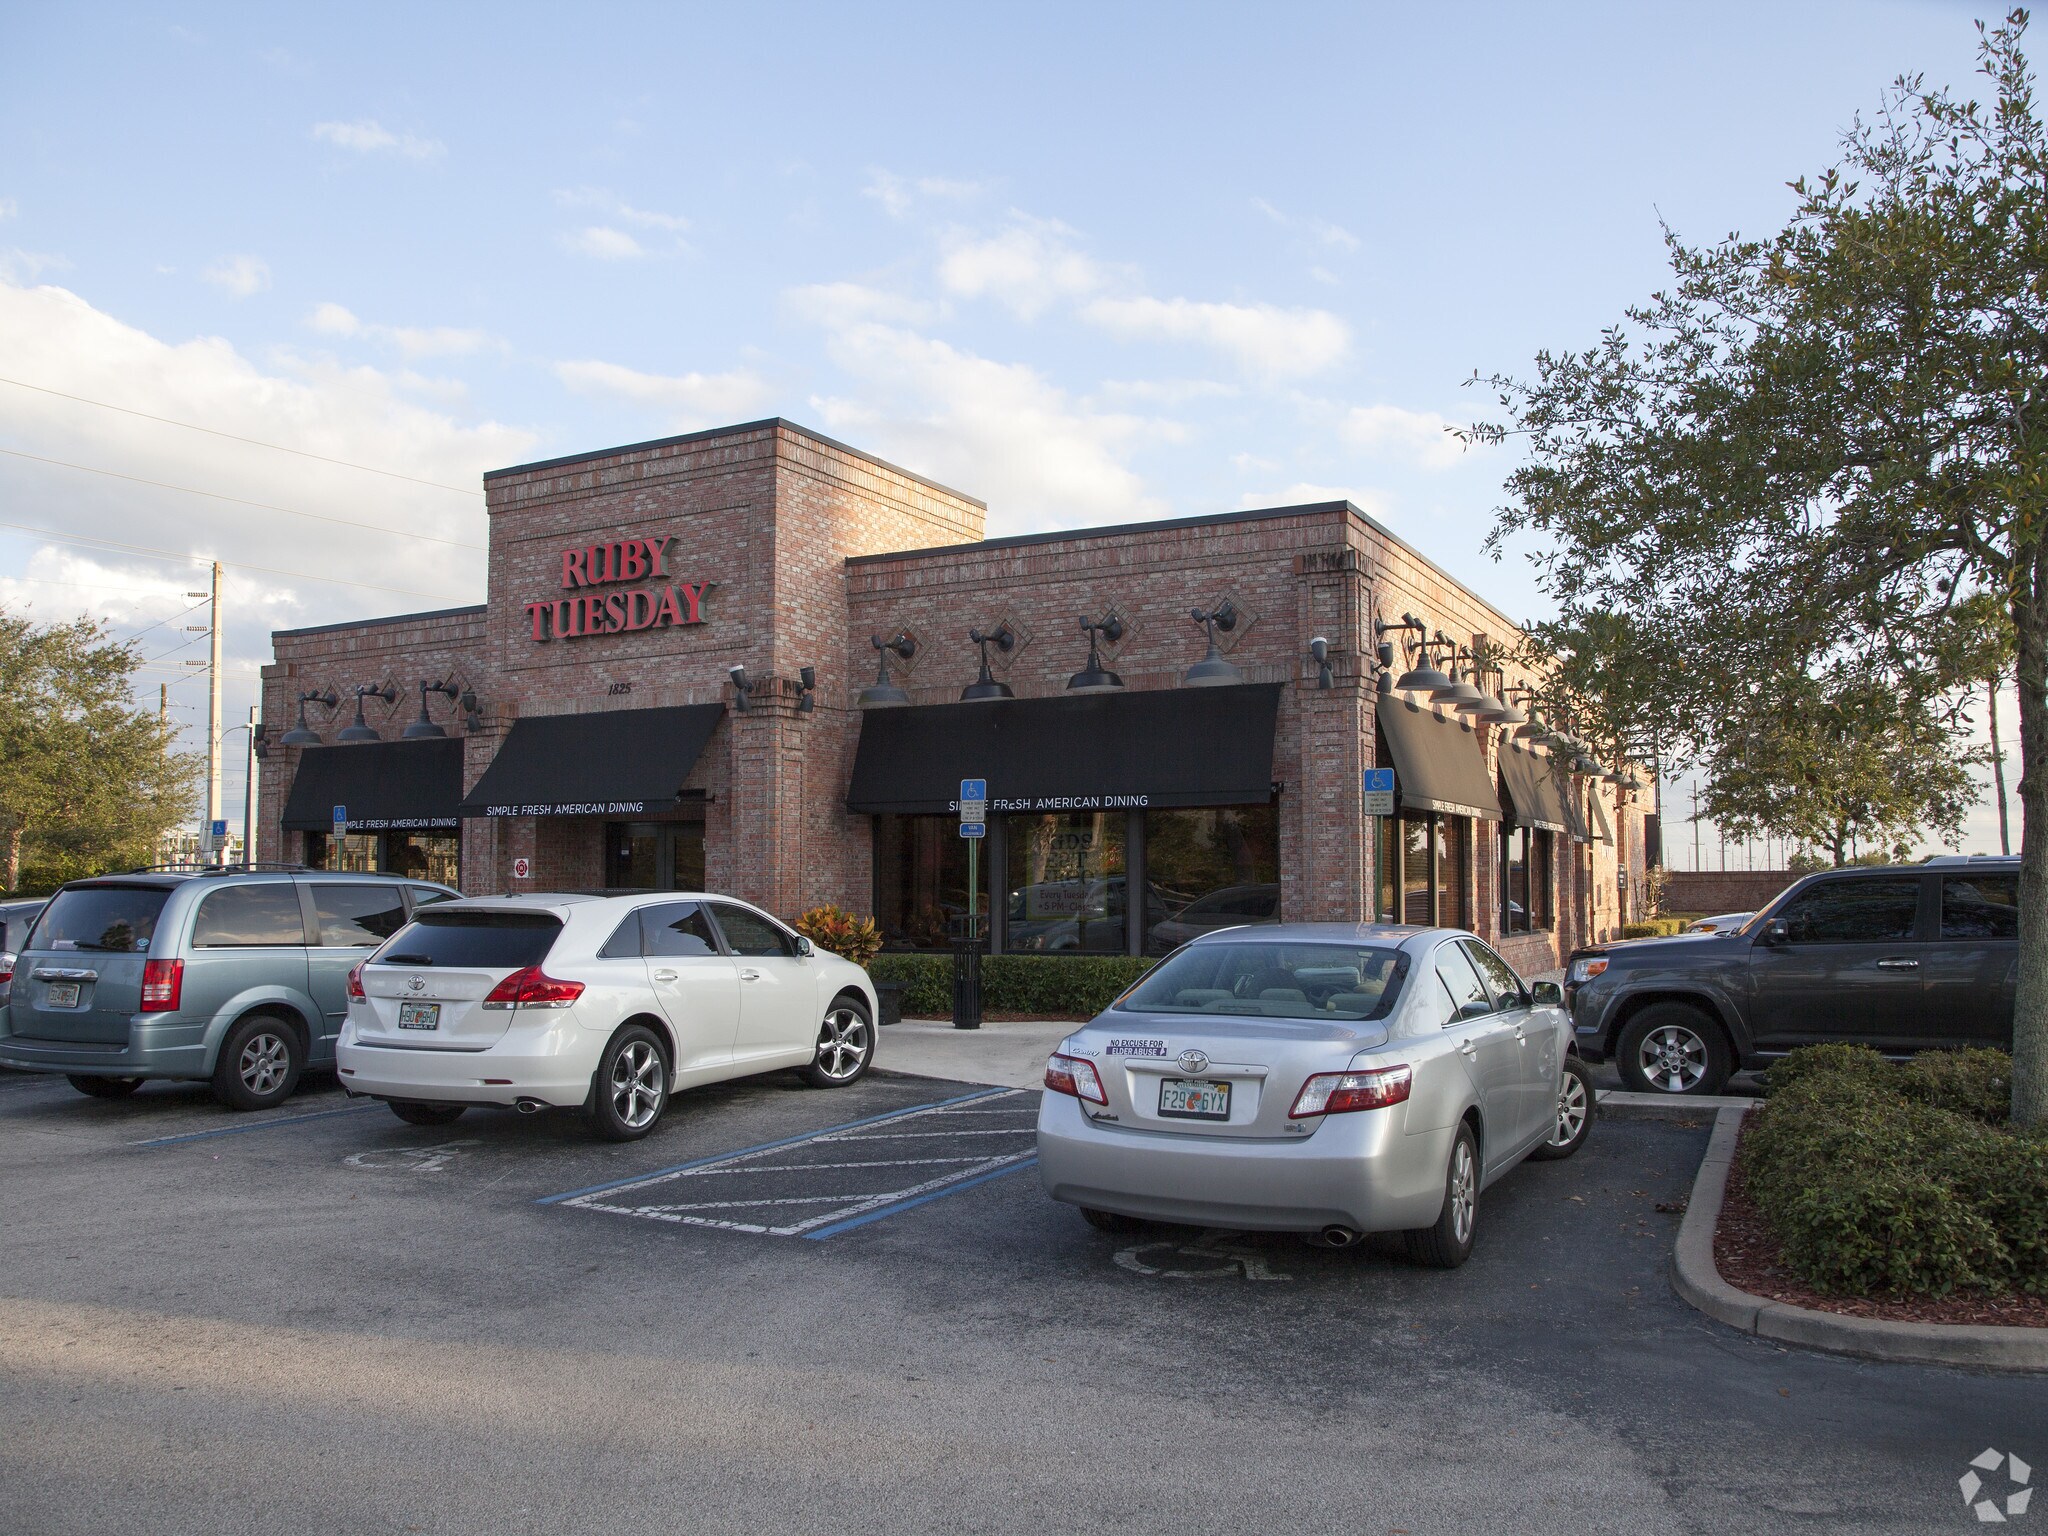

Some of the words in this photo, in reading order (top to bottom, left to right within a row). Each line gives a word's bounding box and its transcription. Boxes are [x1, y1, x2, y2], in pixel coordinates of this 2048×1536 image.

[560, 535, 680, 589] RUBY
[525, 580, 718, 642] TUESDAY
[608, 683, 632, 696] 1825
[486, 805, 518, 817] SIMPLE
[521, 804, 551, 815] FRESH
[555, 803, 605, 815] AMERICAN
[608, 802, 644, 813] DINING
[949, 800, 989, 811] SIE
[1036, 797, 1100, 809] AMERICAN
[1104, 795, 1148, 807] DINING
[345, 820, 364, 830] MPLE
[366, 819, 389, 828] FRESH
[391, 818, 429, 828] AMERICAN
[431, 817, 457, 827] DINING
[1040, 889, 1060, 902] Every
[1110, 1039, 1120, 1047] NO
[1121, 1039, 1148, 1047] EXCUSE
[1149, 1040, 1164, 1048] FOR
[1163, 1089, 1186, 1110] F29
